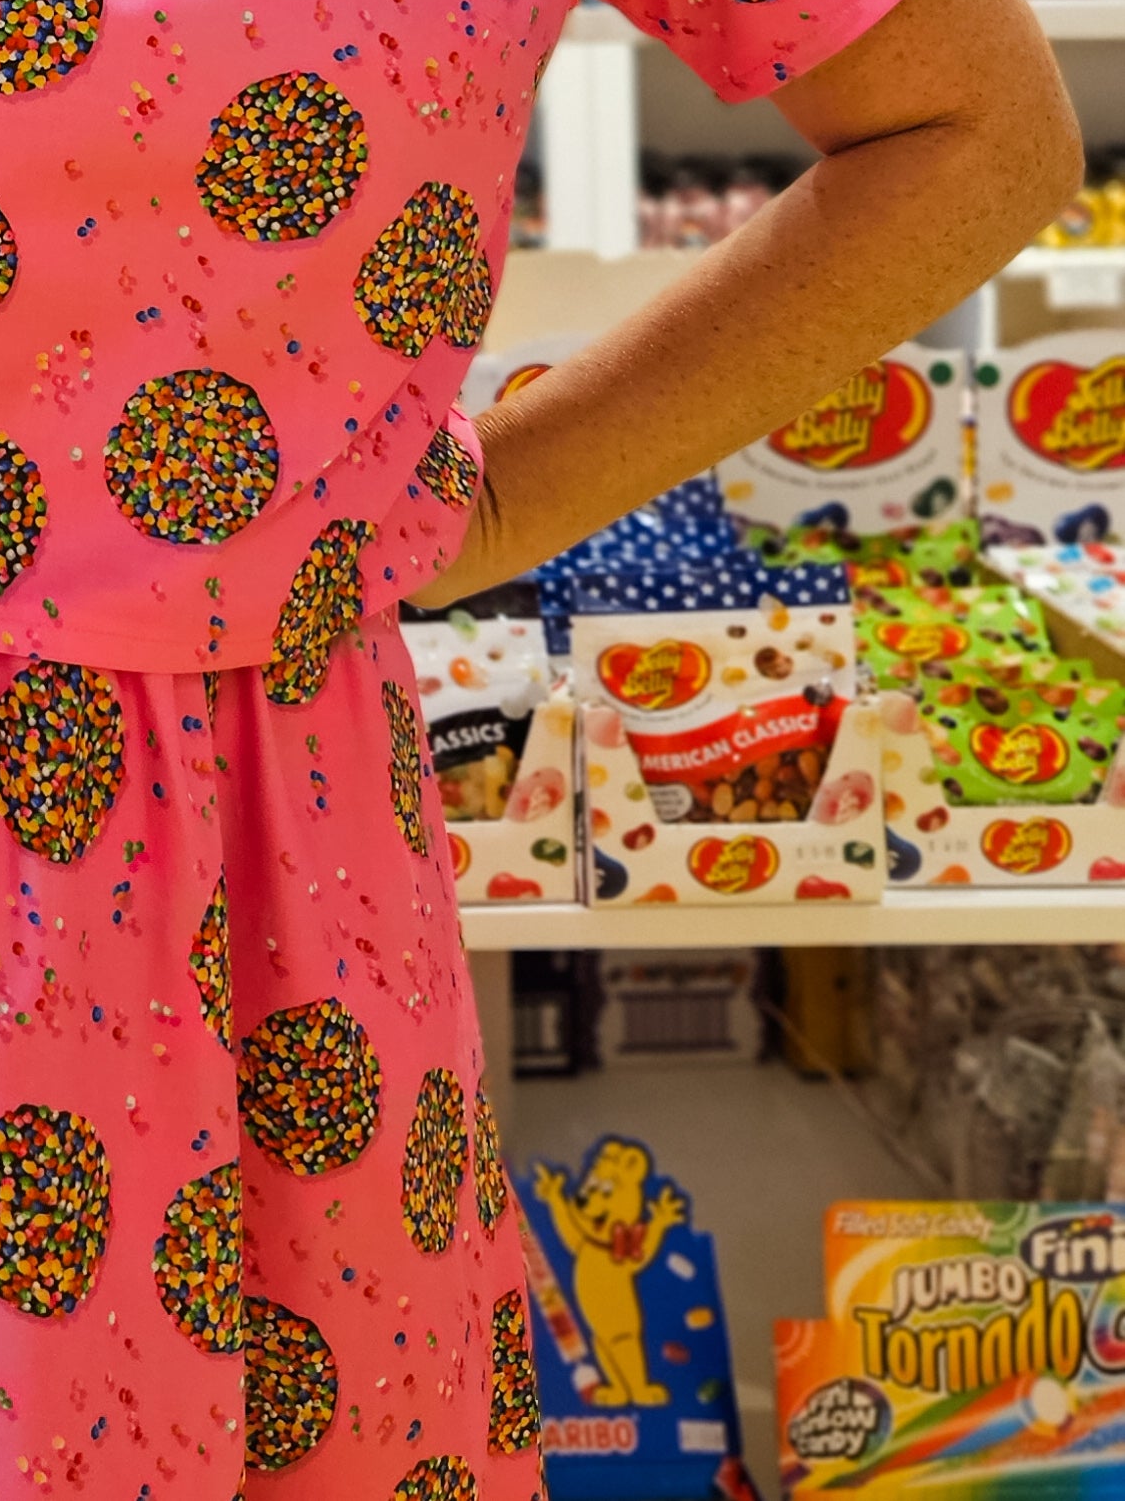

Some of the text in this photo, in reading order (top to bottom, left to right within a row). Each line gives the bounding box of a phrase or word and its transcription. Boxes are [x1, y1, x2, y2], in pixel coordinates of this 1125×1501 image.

[635, 639, 685, 676] Jelly
[621, 670, 676, 709] Belly
[433, 723, 506, 754] ASSICS
[641, 711, 818, 771] MERICAN CLASSICS
[720, 834, 757, 865] Jelly
[1012, 816, 1049, 847] Jelly
[704, 861, 751, 894] Belly
[998, 843, 1043, 875] Belly
[1030, 1223, 1125, 1276] Fini
[894, 1259, 1024, 1321] JUMBO
[855, 1278, 1083, 1391] Tornado
[544, 1417, 637, 1454] ARIBO
